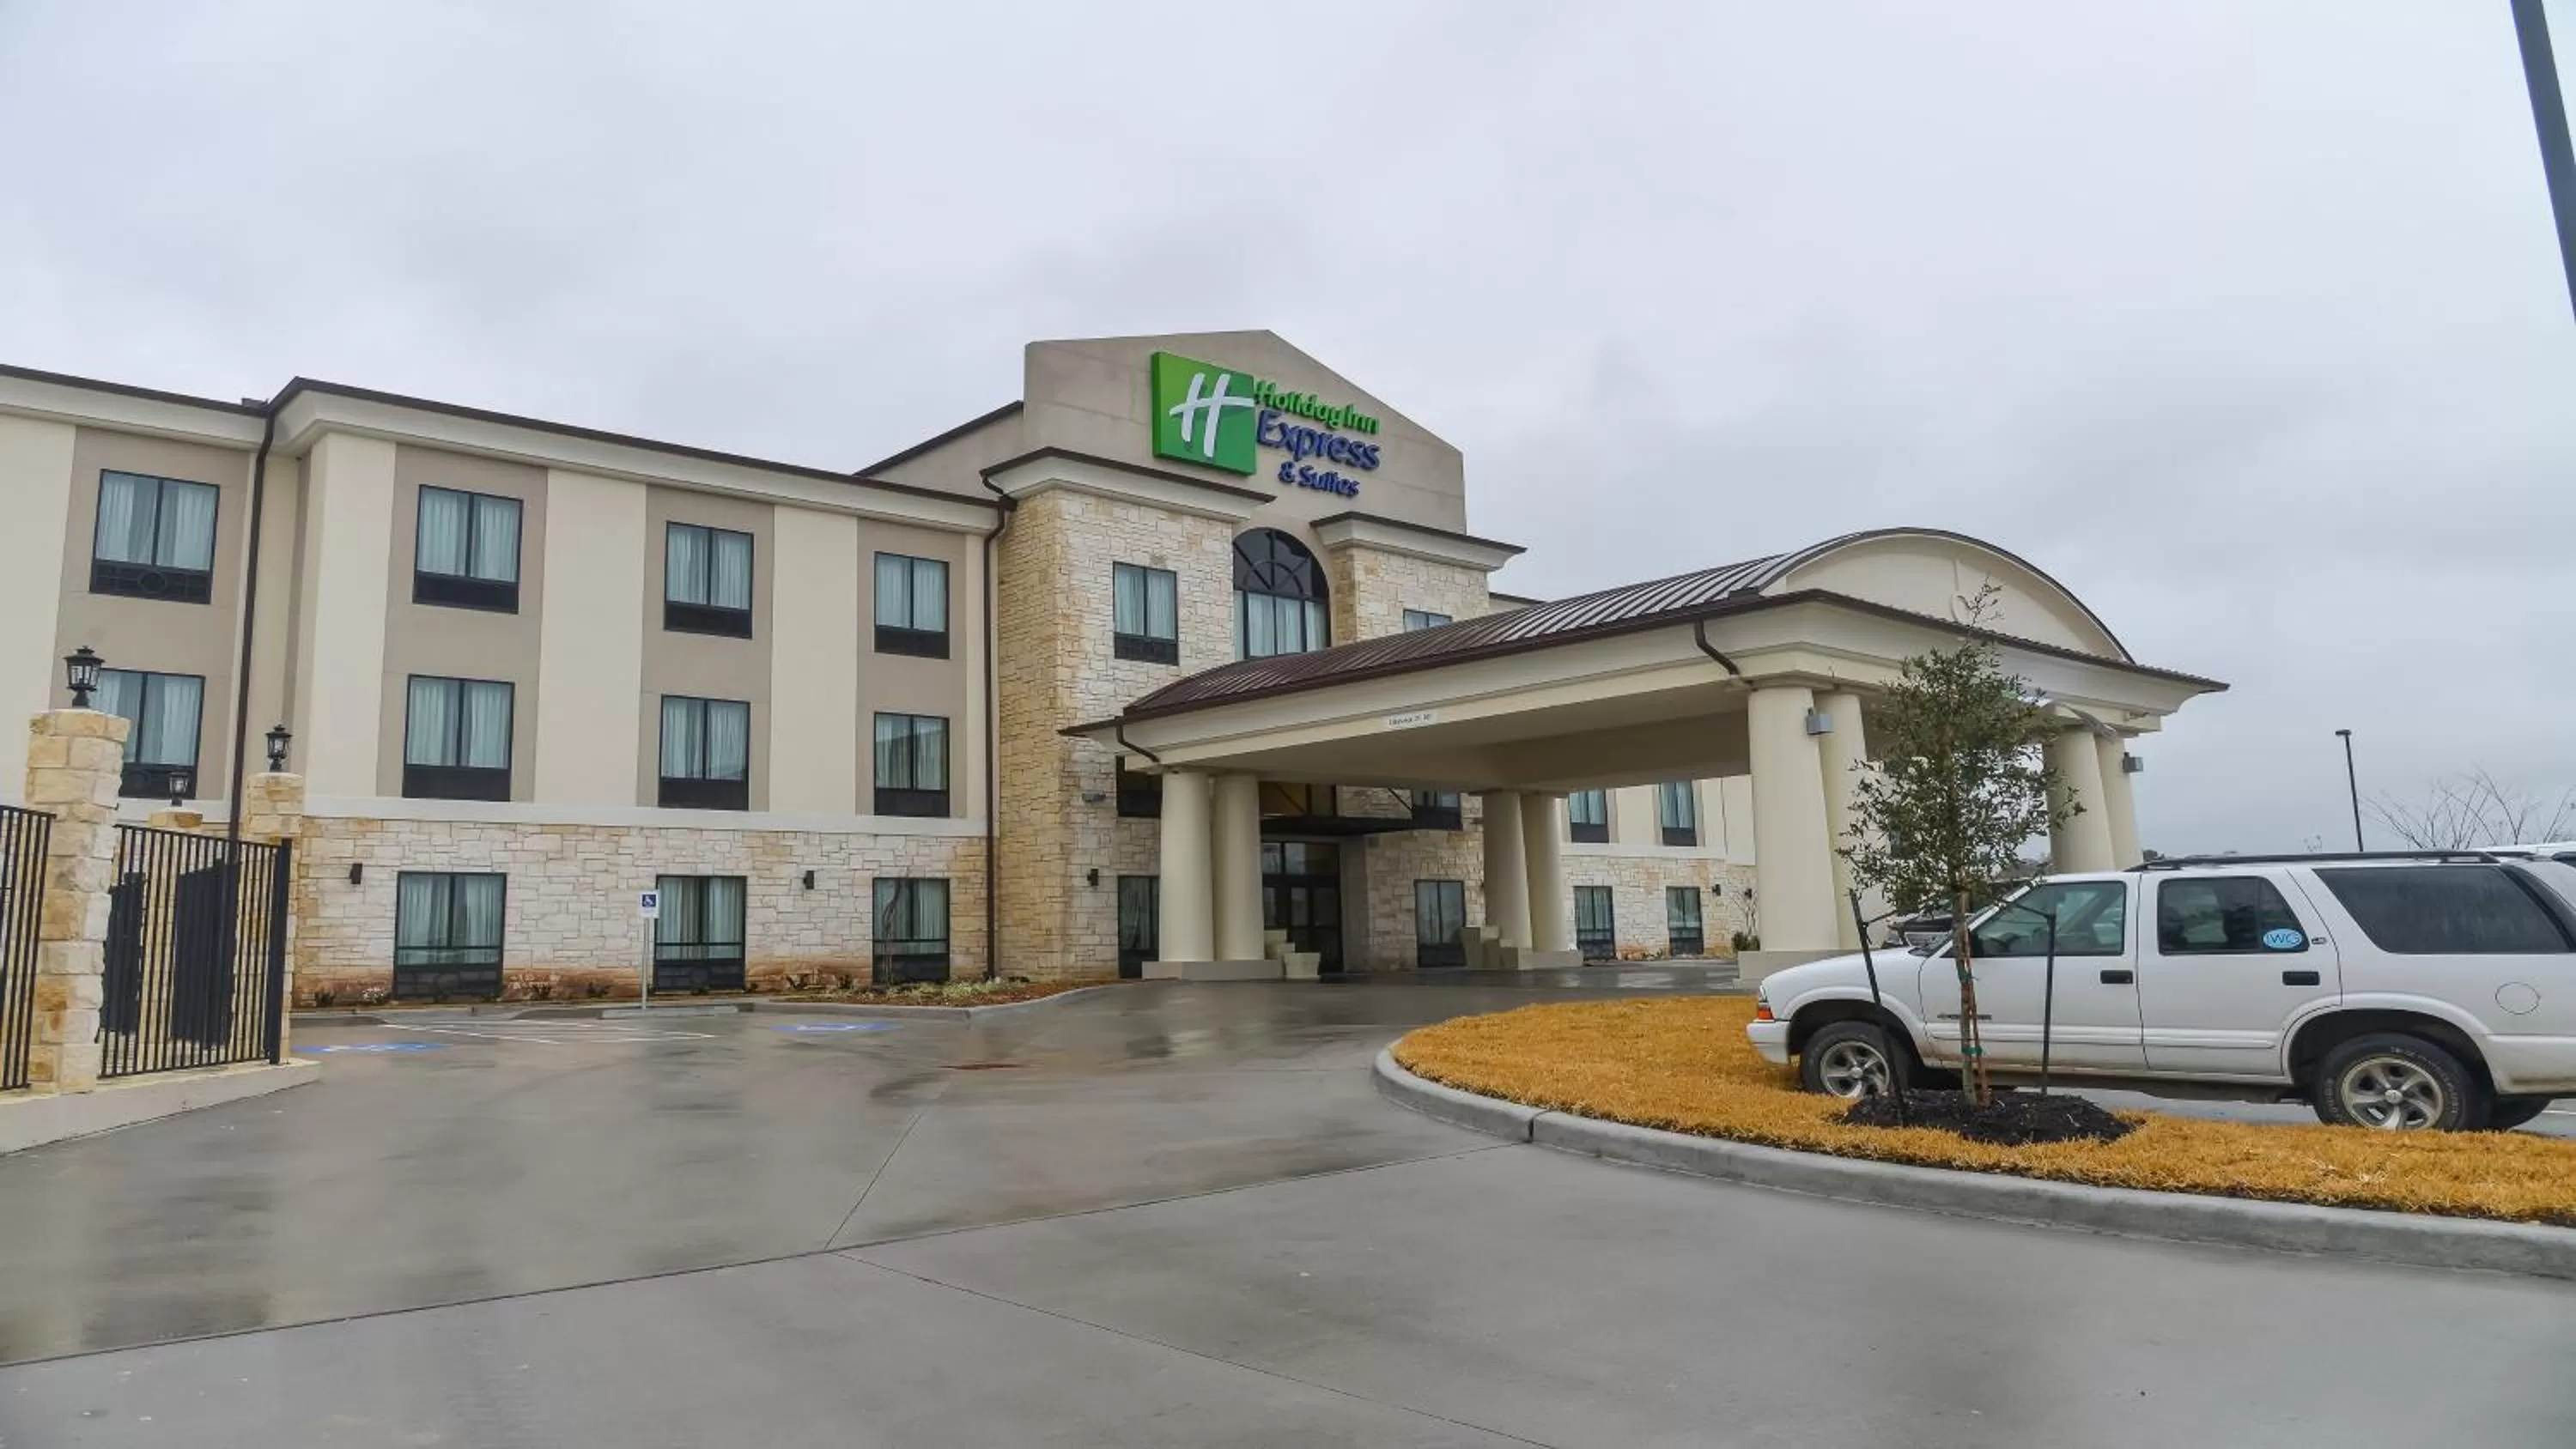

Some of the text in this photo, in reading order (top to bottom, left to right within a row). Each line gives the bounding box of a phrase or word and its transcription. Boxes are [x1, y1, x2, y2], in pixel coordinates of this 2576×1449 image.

[1254, 380, 1381, 435] Holiday Inn
[1256, 409, 1381, 471] Express
[1277, 460, 1360, 498] & Suites
